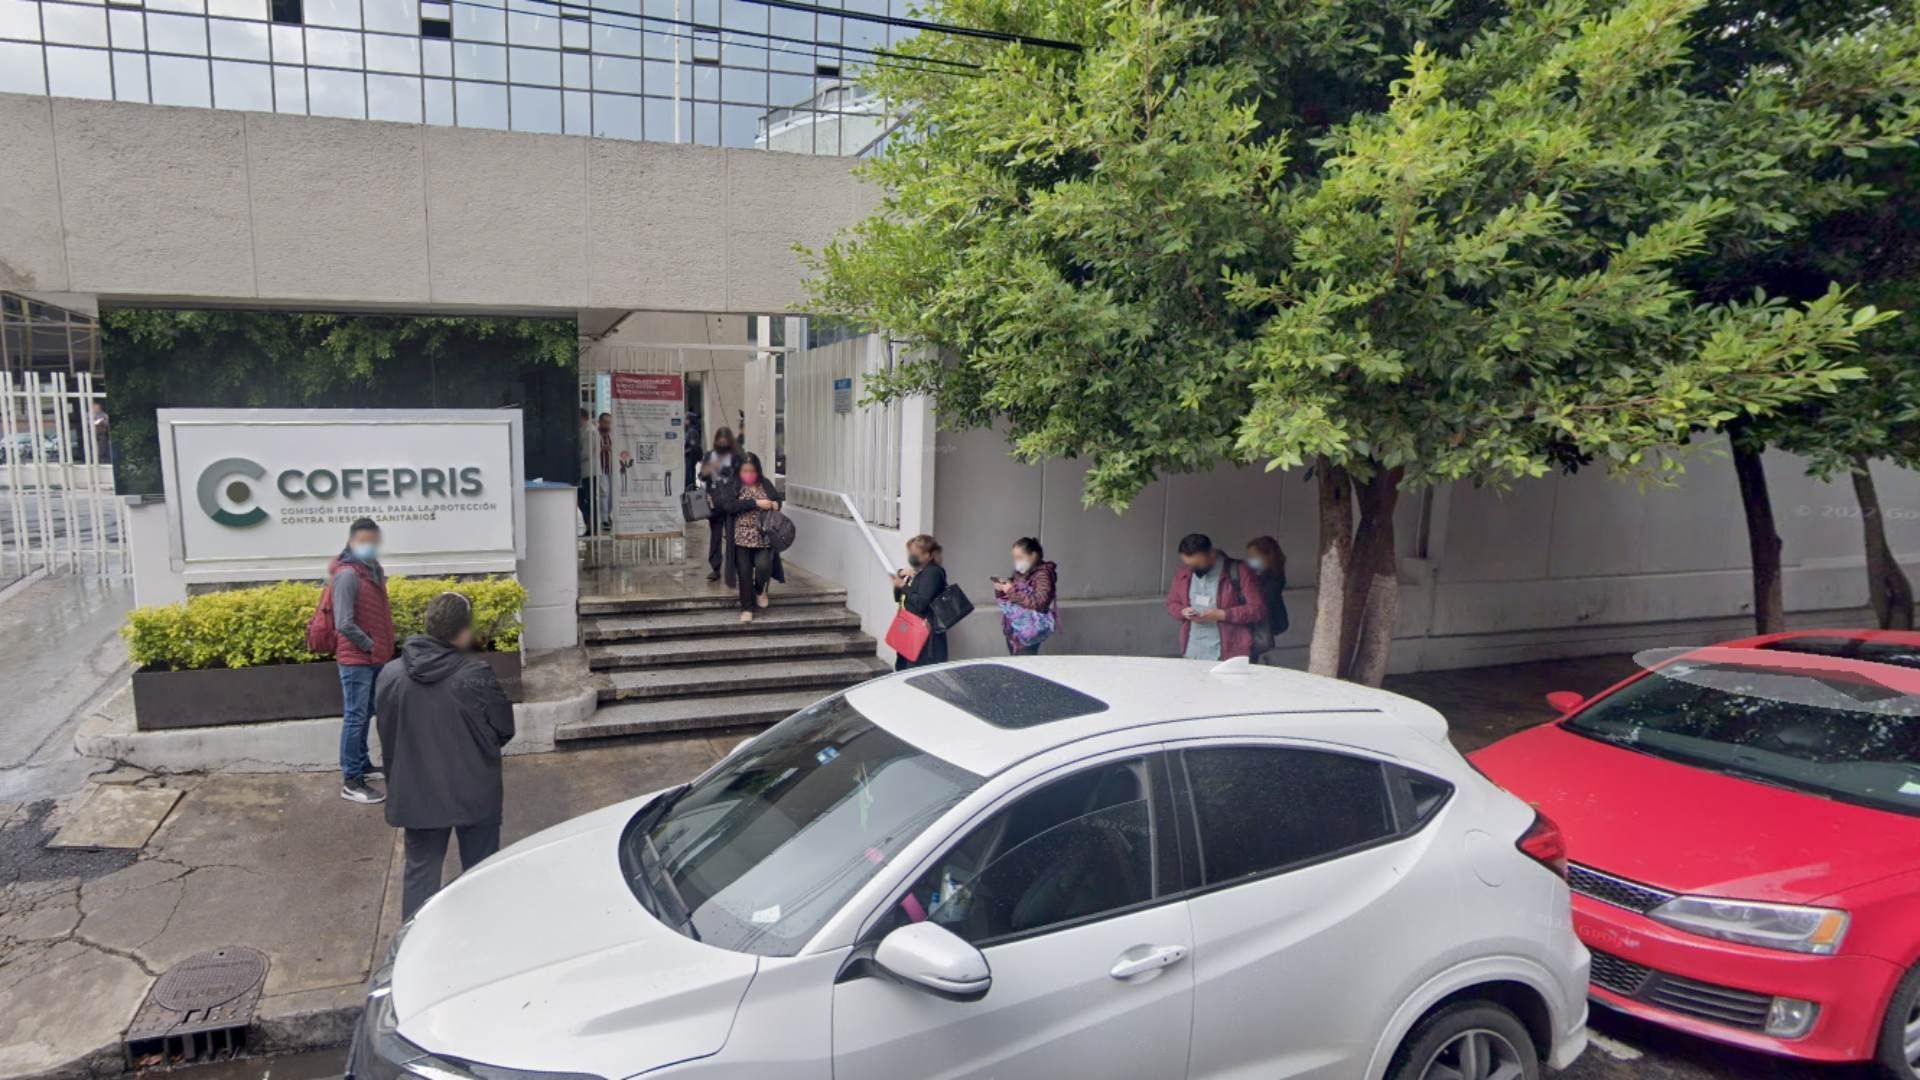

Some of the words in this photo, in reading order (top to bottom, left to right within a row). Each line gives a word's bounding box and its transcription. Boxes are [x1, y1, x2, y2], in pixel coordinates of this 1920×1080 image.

[277, 467, 484, 499] COFEPRIS
[337, 505, 384, 514] FEDERAL
[387, 504, 415, 512] PARA
[281, 515, 324, 525] CONTRA
[376, 512, 436, 522] SANITARIOS
